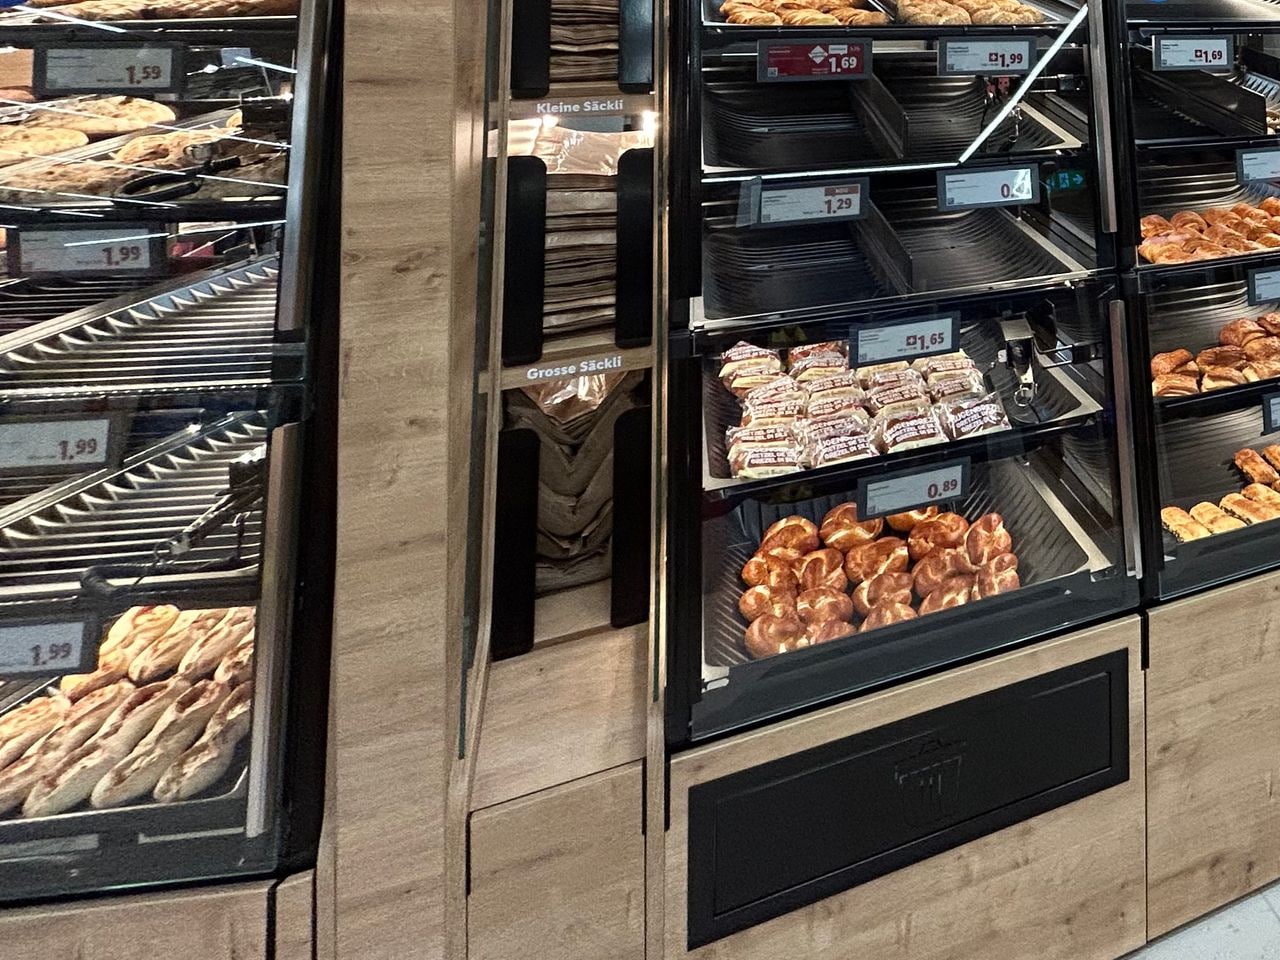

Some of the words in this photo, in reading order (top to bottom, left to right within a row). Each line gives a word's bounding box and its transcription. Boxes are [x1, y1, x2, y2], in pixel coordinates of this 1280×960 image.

[828, 56, 857, 73] 1.69
[999, 53, 1023, 68] 1.99
[1202, 50, 1223, 64] 1.69
[125, 65, 162, 85] 1.59
[536, 102, 580, 114] Kleine
[583, 100, 624, 112] Säckli
[824, 198, 853, 215] 1.29
[102, 245, 142, 267] 1.99
[917, 332, 945, 351] 1.65
[526, 365, 577, 379] Grosse
[580, 356, 623, 372] Säckli
[58, 438, 98, 460] 1.99
[927, 478, 958, 499] 0.89
[30, 642, 73, 667] 1.99
